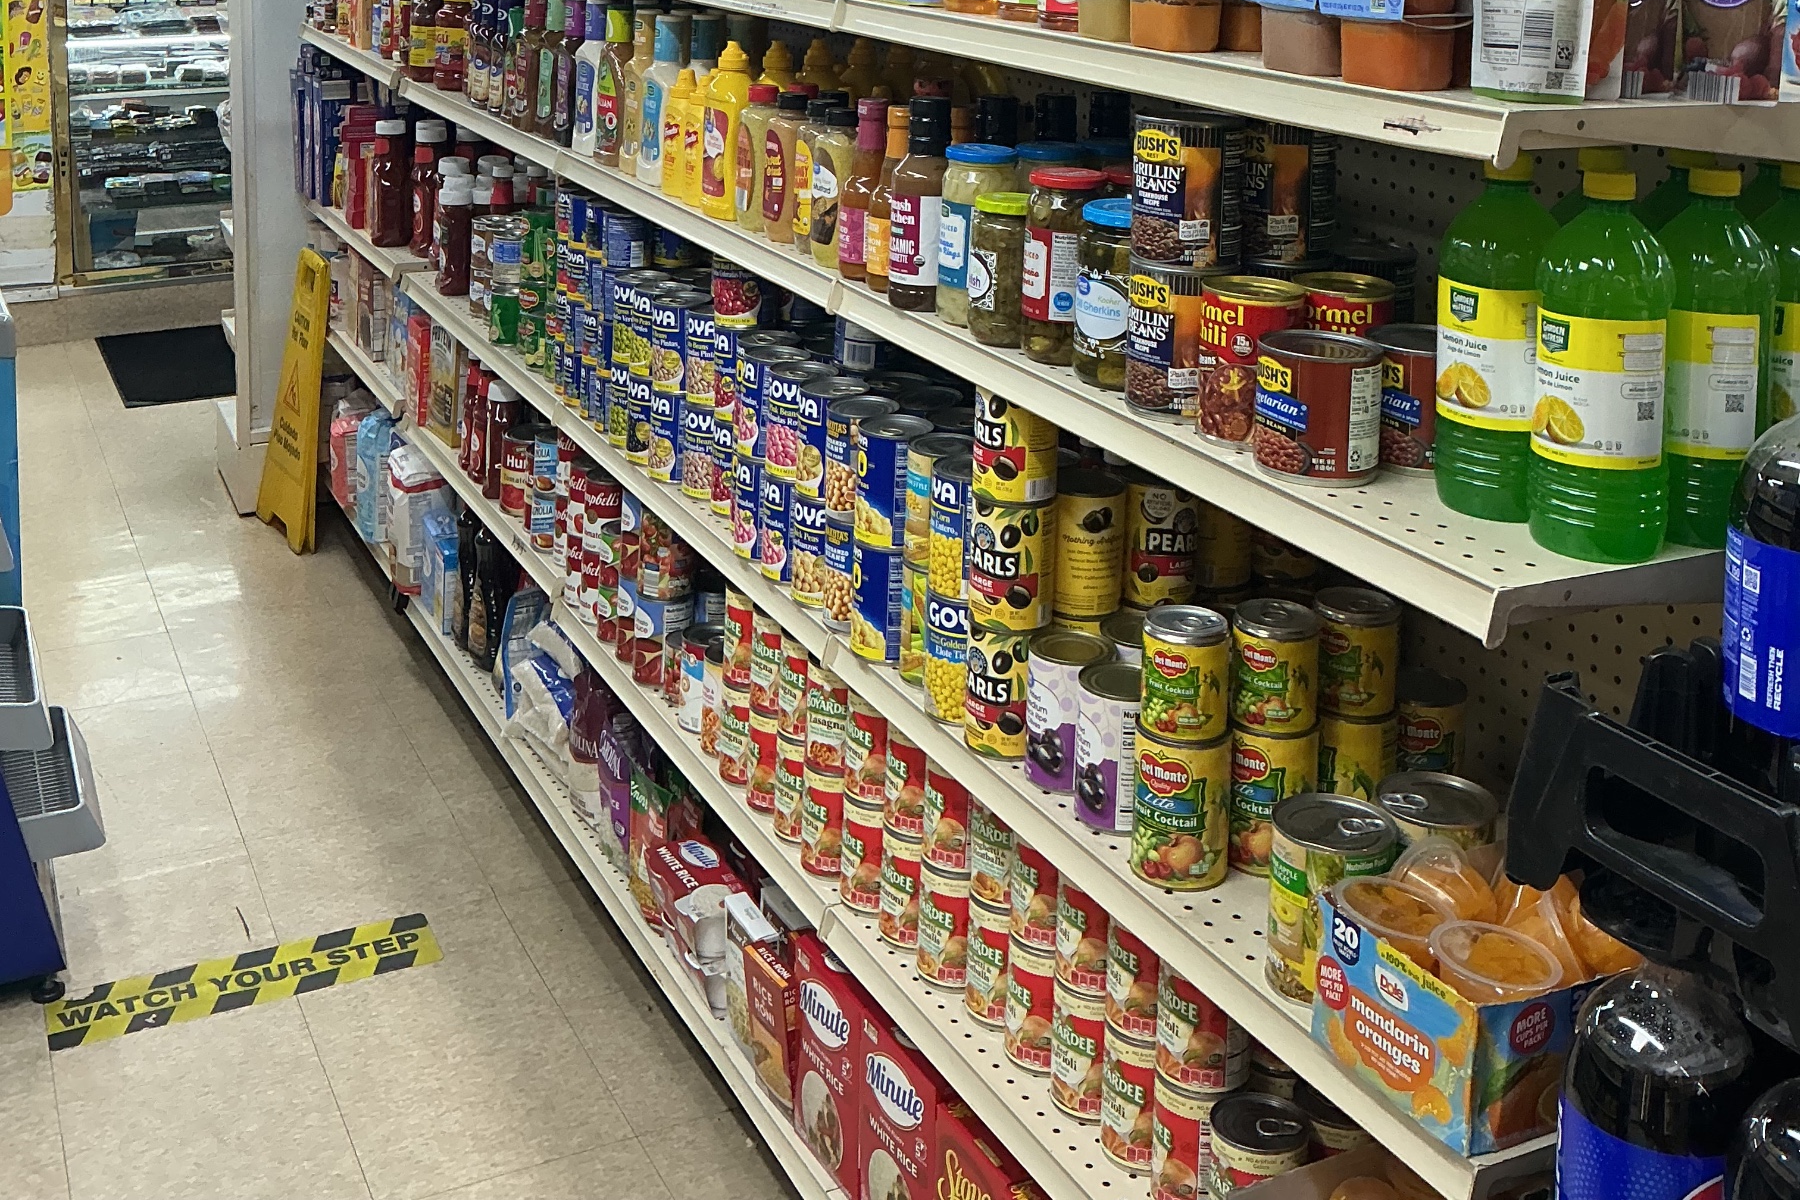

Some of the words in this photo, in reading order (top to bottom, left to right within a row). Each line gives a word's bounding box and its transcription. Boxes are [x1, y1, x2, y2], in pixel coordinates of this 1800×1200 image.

[1137, 136, 1179, 156] BUSH'S
[1133, 155, 1185, 181] GRILLIN'
[1136, 177, 1181, 193] BEANS
[1098, 295, 1122, 306] Kosher
[1129, 281, 1167, 304] BUSH'S
[1453, 292, 1475, 305] GARDEN
[1083, 302, 1121, 318] Gherkins
[1129, 324, 1169, 341] BEANS
[1201, 323, 1227, 347] hili
[1542, 321, 1565, 335] GARDEN
[1443, 332, 1463, 345] Lemon
[1465, 340, 1487, 351] Juice
[1464, 350, 1480, 358] Limon
[1772, 357, 1793, 366] uice
[1555, 370, 1580, 384] Juice
[1555, 382, 1573, 391] Limon
[936, 511, 950, 523] Corn
[804, 532, 819, 543] Peas
[971, 572, 993, 588] LARGE
[935, 645, 952, 657] Elote
[940, 637, 966, 649] Golden
[1154, 656, 1164, 665] Del
[1165, 658, 1187, 669] Monte
[1244, 648, 1253, 657] Del
[1254, 651, 1276, 663] Monte
[1149, 678, 1163, 689] Fruit
[1165, 684, 1194, 695] Cocktail
[1254, 678, 1283, 690] Cocktail
[1773, 649, 1784, 711] RECYCLE
[809, 715, 845, 731] Lasagna
[1236, 755, 1266, 771] Monte
[1141, 761, 1155, 775] Del
[1156, 765, 1188, 784] Monte
[1150, 779, 1172, 791] Quality
[1144, 795, 1176, 810] Lite
[1154, 811, 1197, 827] Cocktail
[680, 840, 720, 869] Minute
[657, 845, 680, 875] WHITE
[676, 866, 698, 889] RICE
[1346, 860, 1373, 871] Nutrition
[1333, 917, 1359, 949] 20
[758, 946, 771, 962] RICE
[775, 964, 791, 980] RONI
[57, 983, 199, 1028] WATCH
[210, 957, 317, 993] YOUR
[326, 932, 420, 967] STEP
[1320, 963, 1343, 981] MORE
[1385, 951, 1407, 972] 100%
[1421, 974, 1446, 999] juice
[752, 976, 774, 1007] RICE
[1319, 978, 1332, 989] CUPS
[1333, 983, 1344, 993] PER
[1379, 973, 1404, 1003] Dole
[1325, 990, 1341, 1002] PACK!
[755, 1001, 775, 1027] RONI
[800, 980, 850, 1042] Minute
[1351, 994, 1430, 1060] mandarin
[1516, 1007, 1548, 1035] MORE
[1515, 1025, 1534, 1043] CUPS
[1535, 1020, 1549, 1033] PER
[1355, 1019, 1421, 1075] oranges
[1523, 1032, 1545, 1049] PACK!
[802, 1038, 825, 1074] WHITE
[825, 1070, 844, 1097] RICE
[866, 1055, 924, 1125] Minute
[869, 1117, 895, 1156] WHITE
[896, 1150, 918, 1179] RICE
